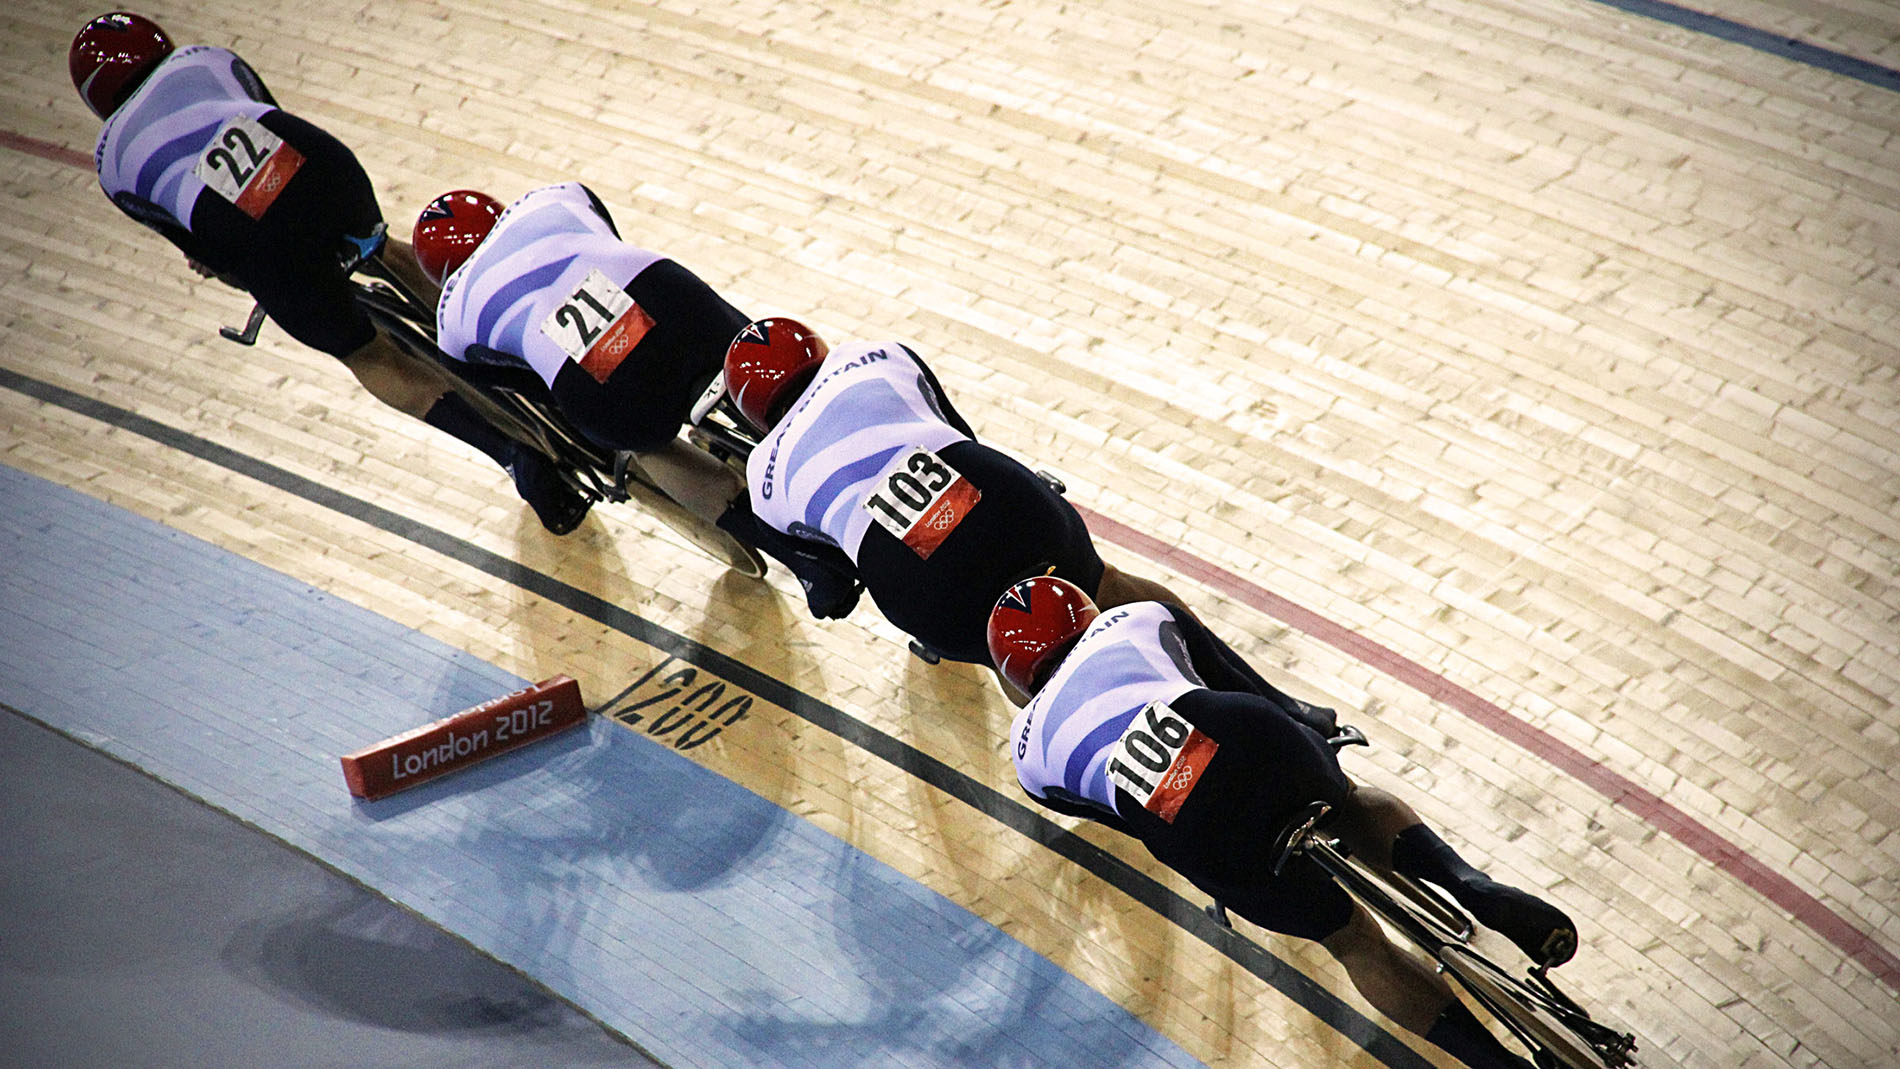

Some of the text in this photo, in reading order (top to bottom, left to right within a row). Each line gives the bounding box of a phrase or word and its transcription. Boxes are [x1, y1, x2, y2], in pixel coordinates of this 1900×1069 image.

[206, 128, 270, 188] 22
[555, 289, 615, 347] 21
[867, 452, 951, 529] 103
[393, 730, 488, 779] London
[496, 701, 552, 740] 2012
[1109, 706, 1189, 795] 106
